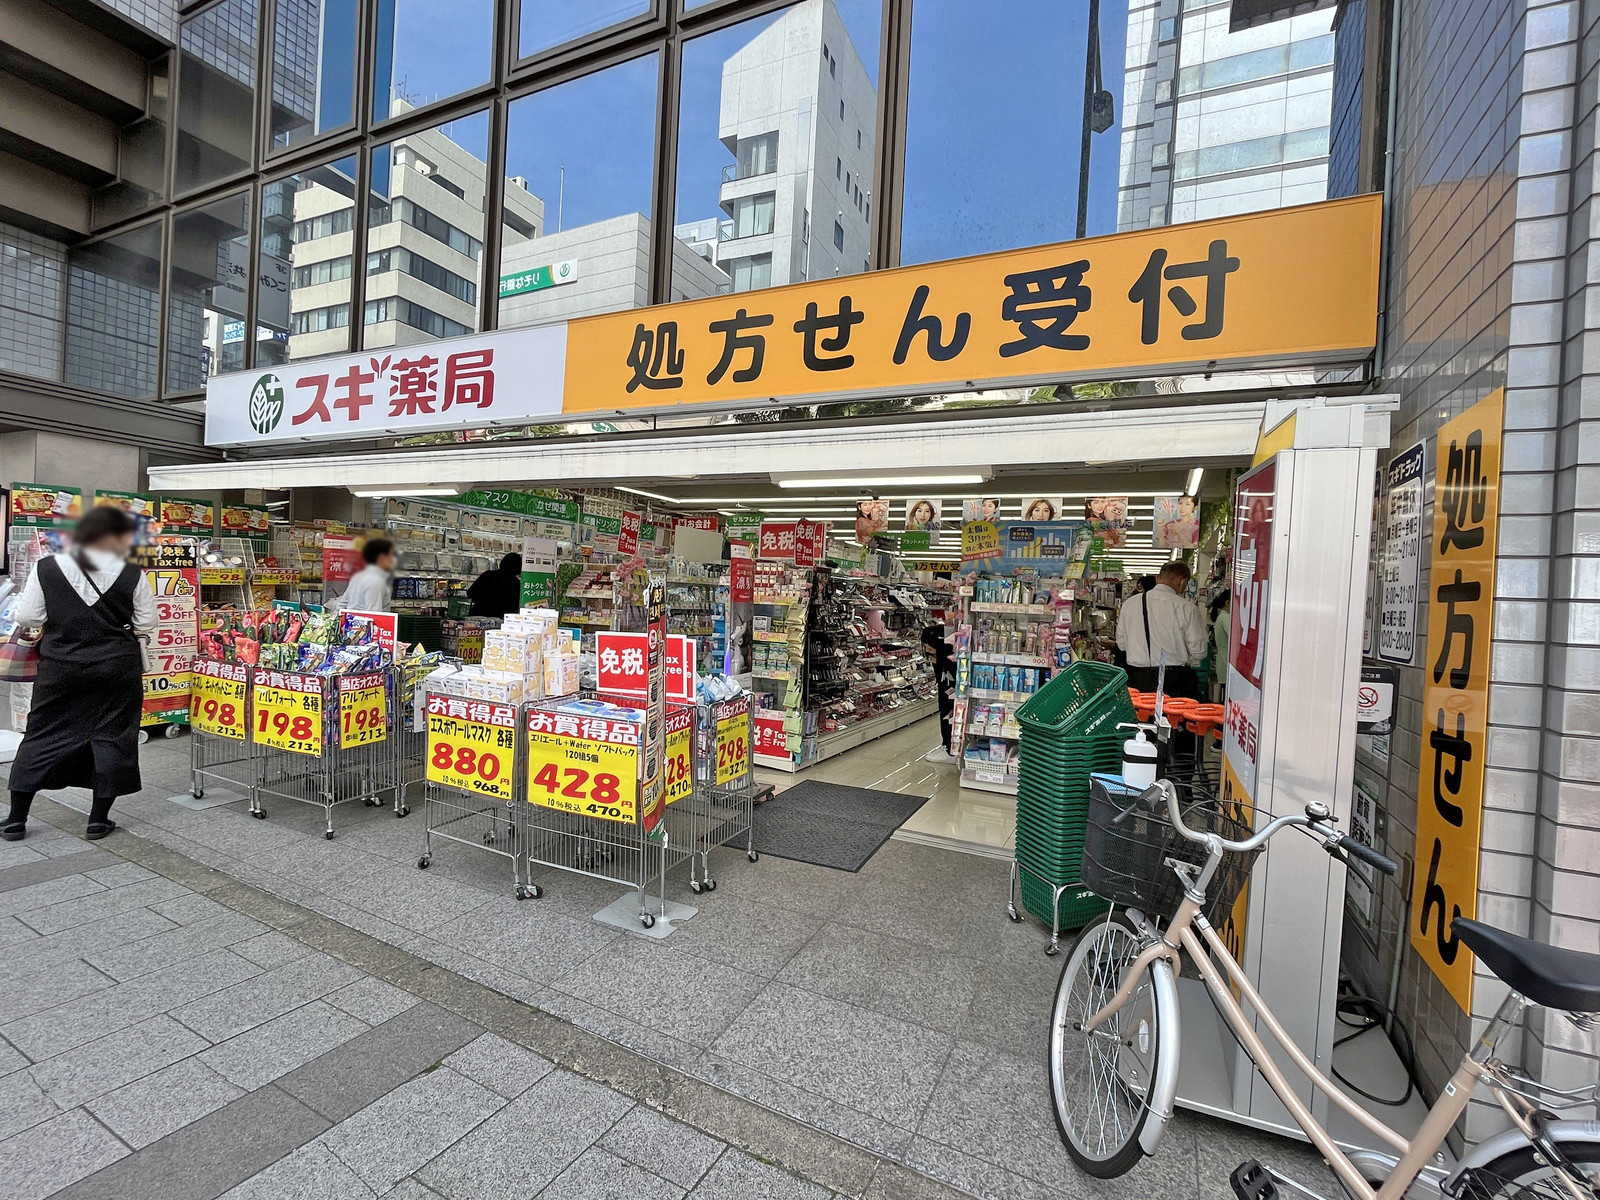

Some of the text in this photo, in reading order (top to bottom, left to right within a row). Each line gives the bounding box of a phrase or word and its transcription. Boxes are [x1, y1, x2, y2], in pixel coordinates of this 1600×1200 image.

[626, 239, 1240, 393] 処方せん受付
[291, 348, 495, 426] スギ薬局
[1388, 451, 1423, 486] スギドラッグ
[484, 490, 509, 503] マスク
[622, 515, 639, 532] 免税
[796, 523, 815, 539] 免税
[762, 531, 795, 550] 免税
[152, 558, 193, 568] Tax-free
[193, 659, 247, 683] お買得品
[600, 647, 645, 676] 免税
[255, 671, 322, 693] お買得品
[340, 674, 384, 691] 当店オススメ
[302, 696, 319, 712] 各種
[341, 690, 380, 704] アルフォート
[1421, 428, 1486, 967] 処方せん
[428, 698, 515, 727] お買得品
[716, 701, 749, 721] 当店オススメ
[430, 717, 514, 749] エスポワールマスク 各種
[529, 714, 638, 745] お買得品
[594, 743, 635, 757] ソフトパック
